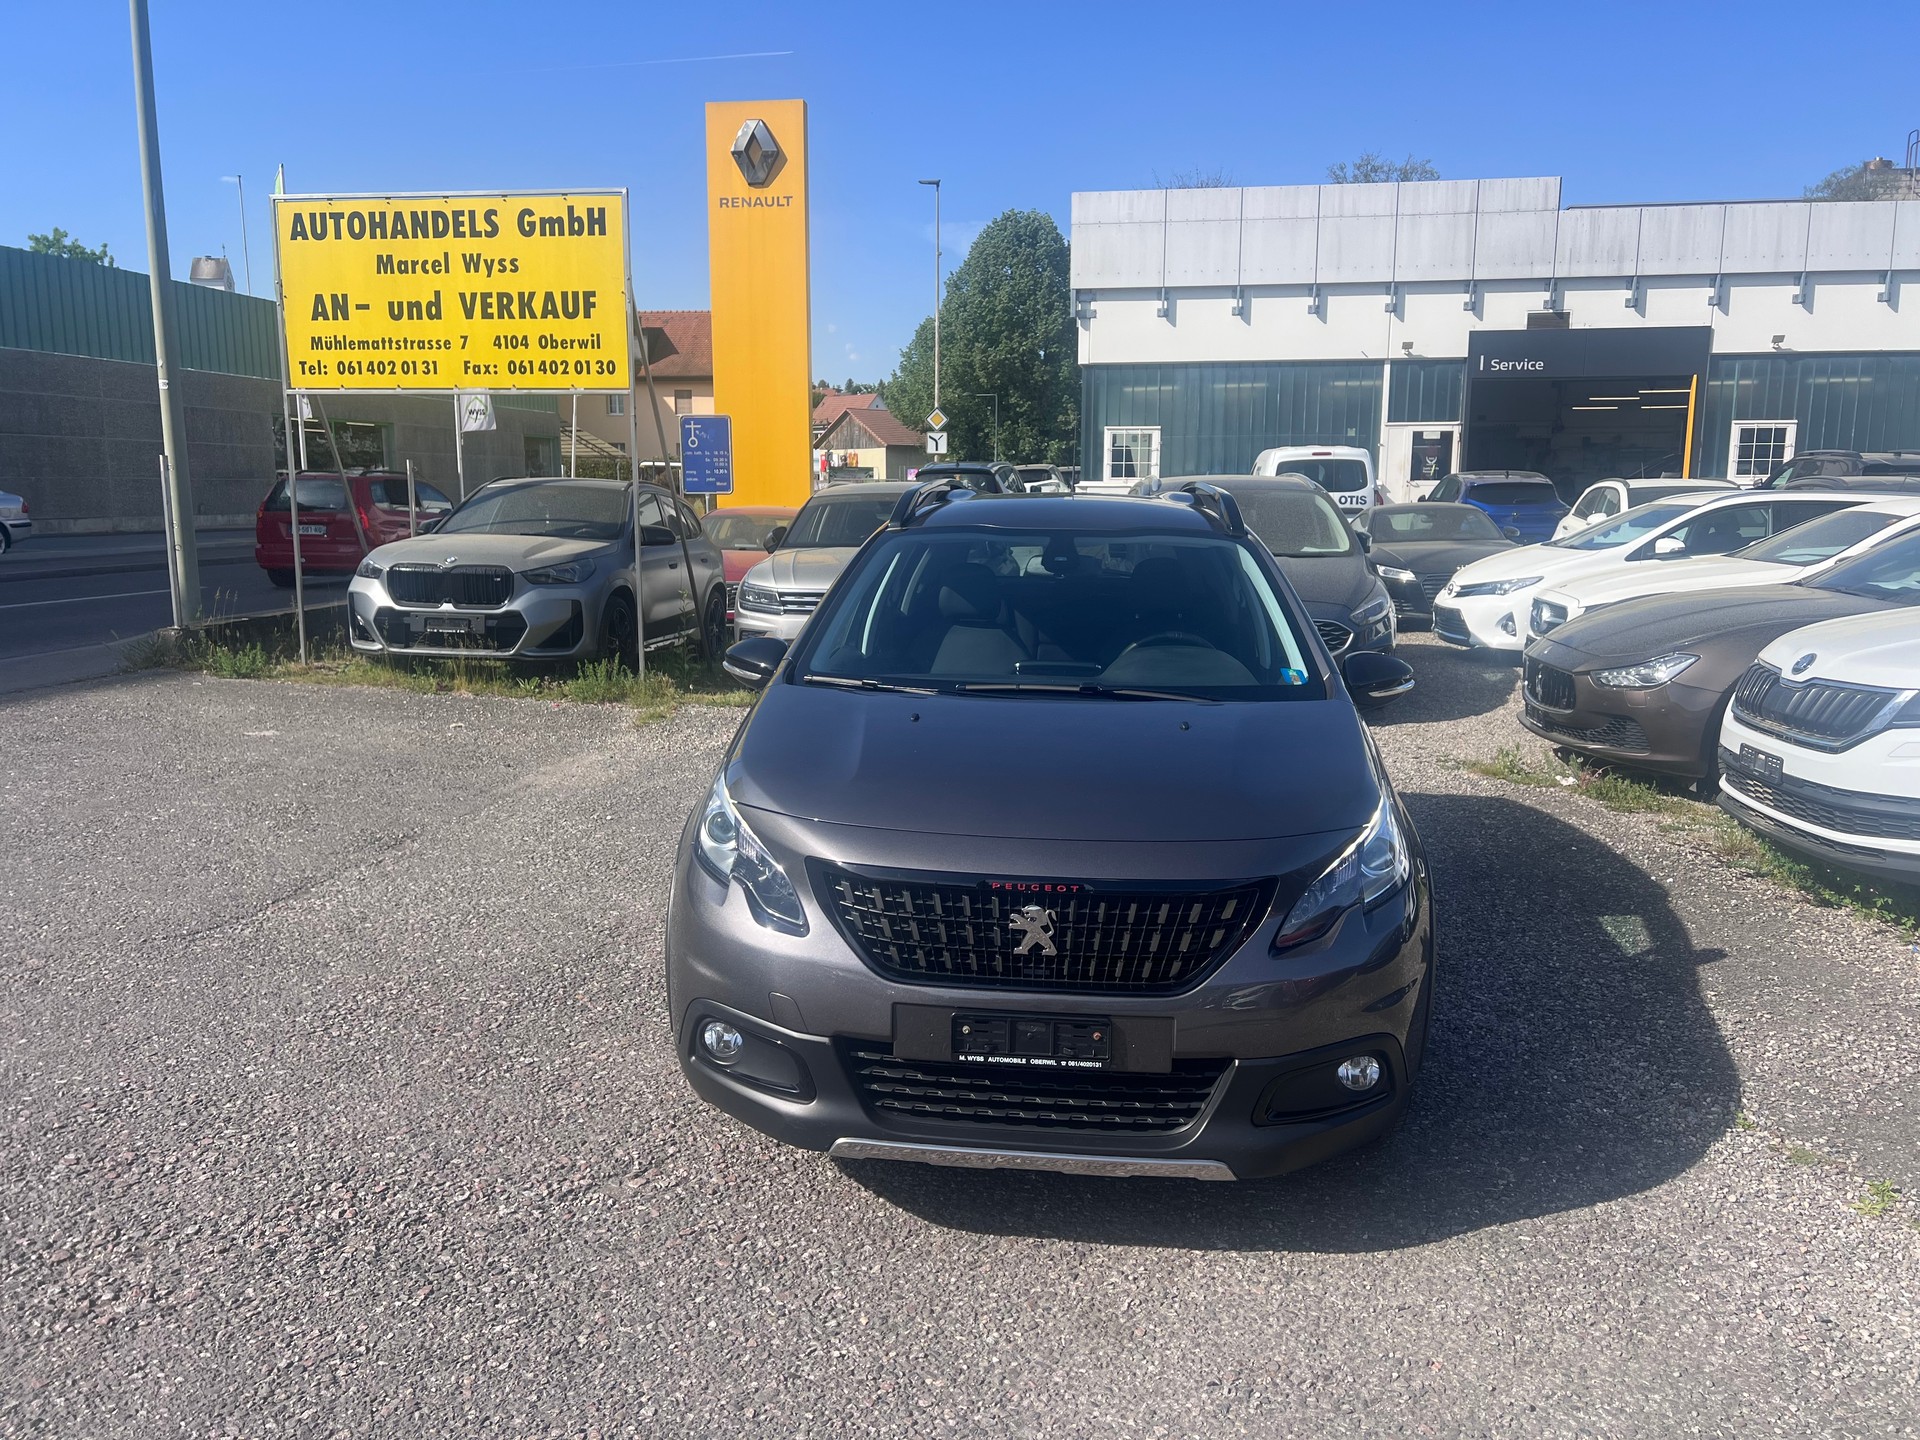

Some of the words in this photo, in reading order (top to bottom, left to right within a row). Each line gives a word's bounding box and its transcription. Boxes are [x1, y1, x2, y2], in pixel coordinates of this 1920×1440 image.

[720, 196, 793, 208] RENAULT
[290, 209, 499, 240] AUTOHANDELS
[517, 205, 606, 237] GmbH
[377, 252, 449, 274] Marcel
[462, 253, 519, 278] Wyss
[311, 294, 370, 321] AN-
[388, 290, 442, 321] und
[459, 291, 596, 319] VERKAUF
[311, 335, 451, 350] Mühlemattstrasse
[460, 336, 468, 349] 7
[493, 335, 529, 349] 4104
[538, 334, 600, 349] Oberwil
[299, 360, 327, 375] Tel:
[464, 361, 497, 374] Fax:
[1490, 358, 1544, 371] Service
[1338, 495, 1367, 506] OTIS
[992, 882, 1079, 892] PEUGEOT
